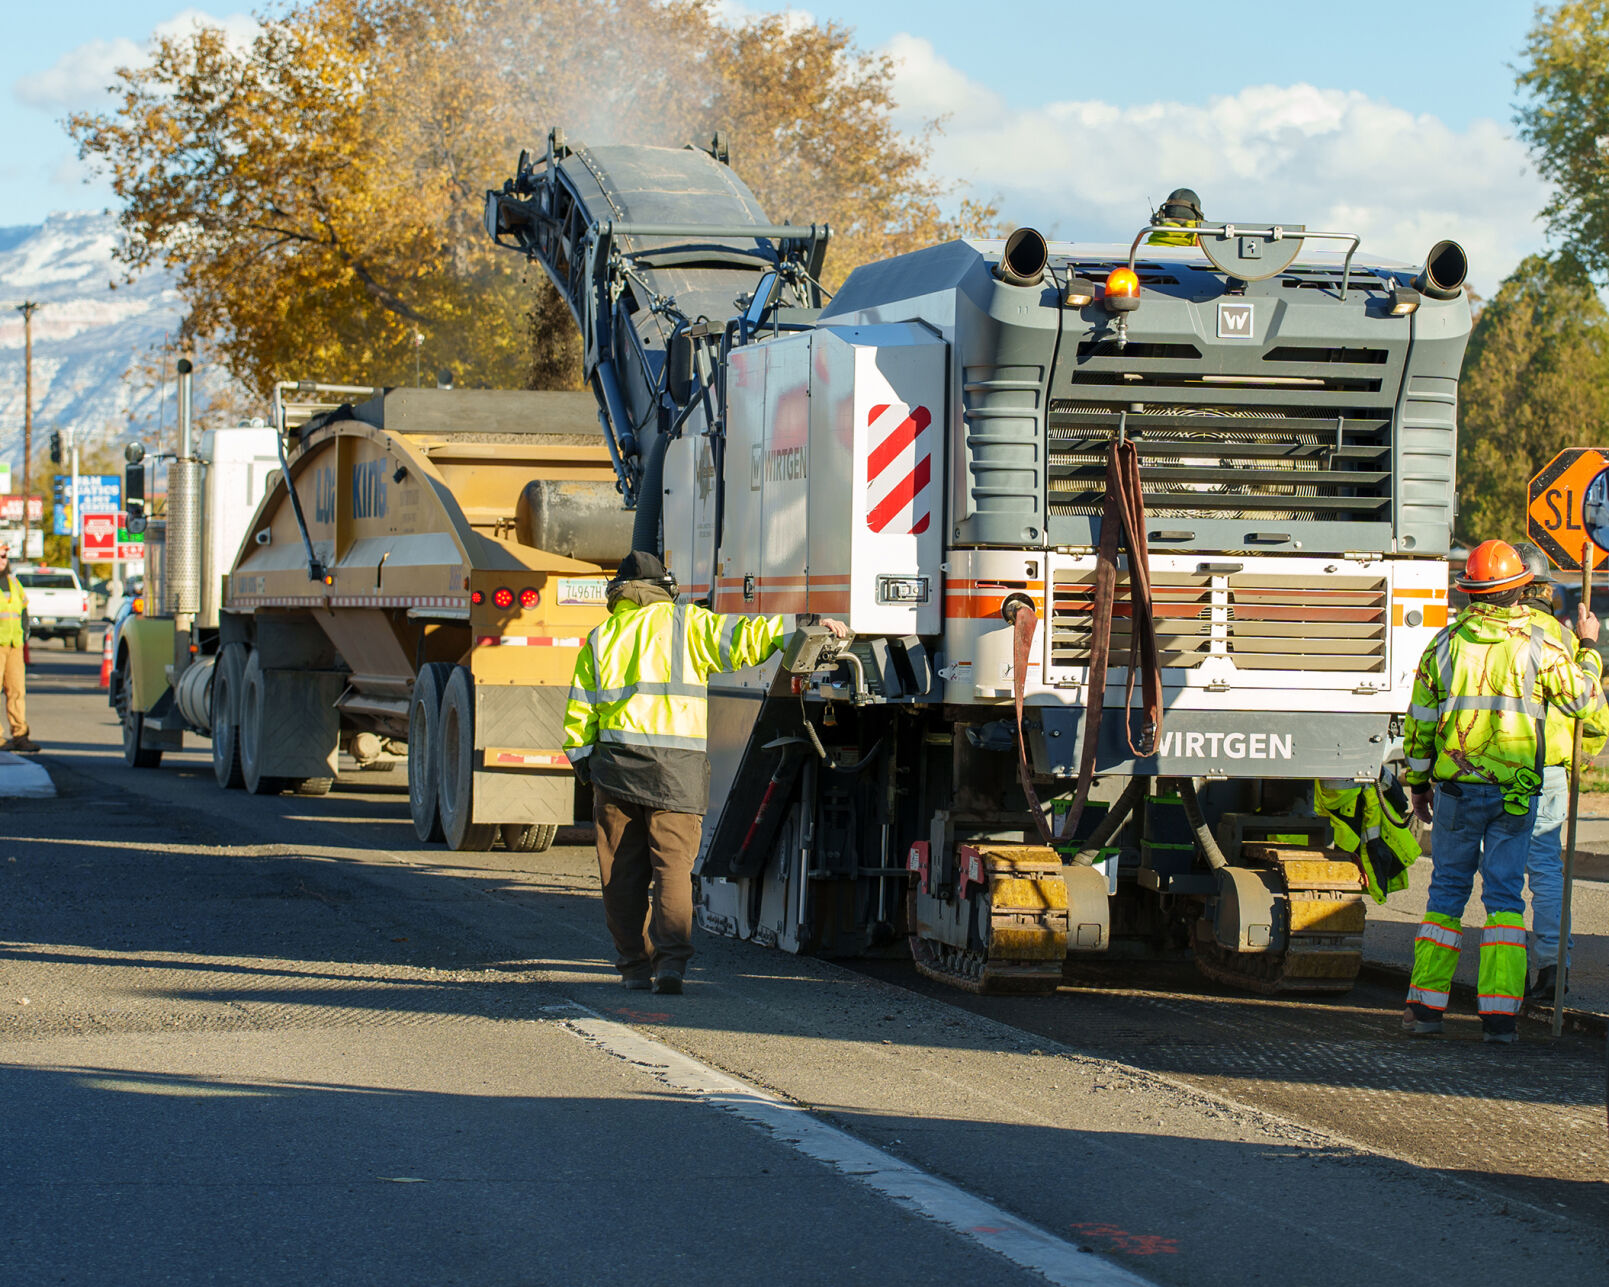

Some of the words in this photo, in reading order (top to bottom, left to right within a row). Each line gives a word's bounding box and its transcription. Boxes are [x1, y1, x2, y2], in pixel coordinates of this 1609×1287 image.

[1223, 311, 1249, 330] W
[764, 446, 807, 482] WIRTGEN
[1544, 489, 1582, 531] SL
[566, 585, 602, 599] 74967H
